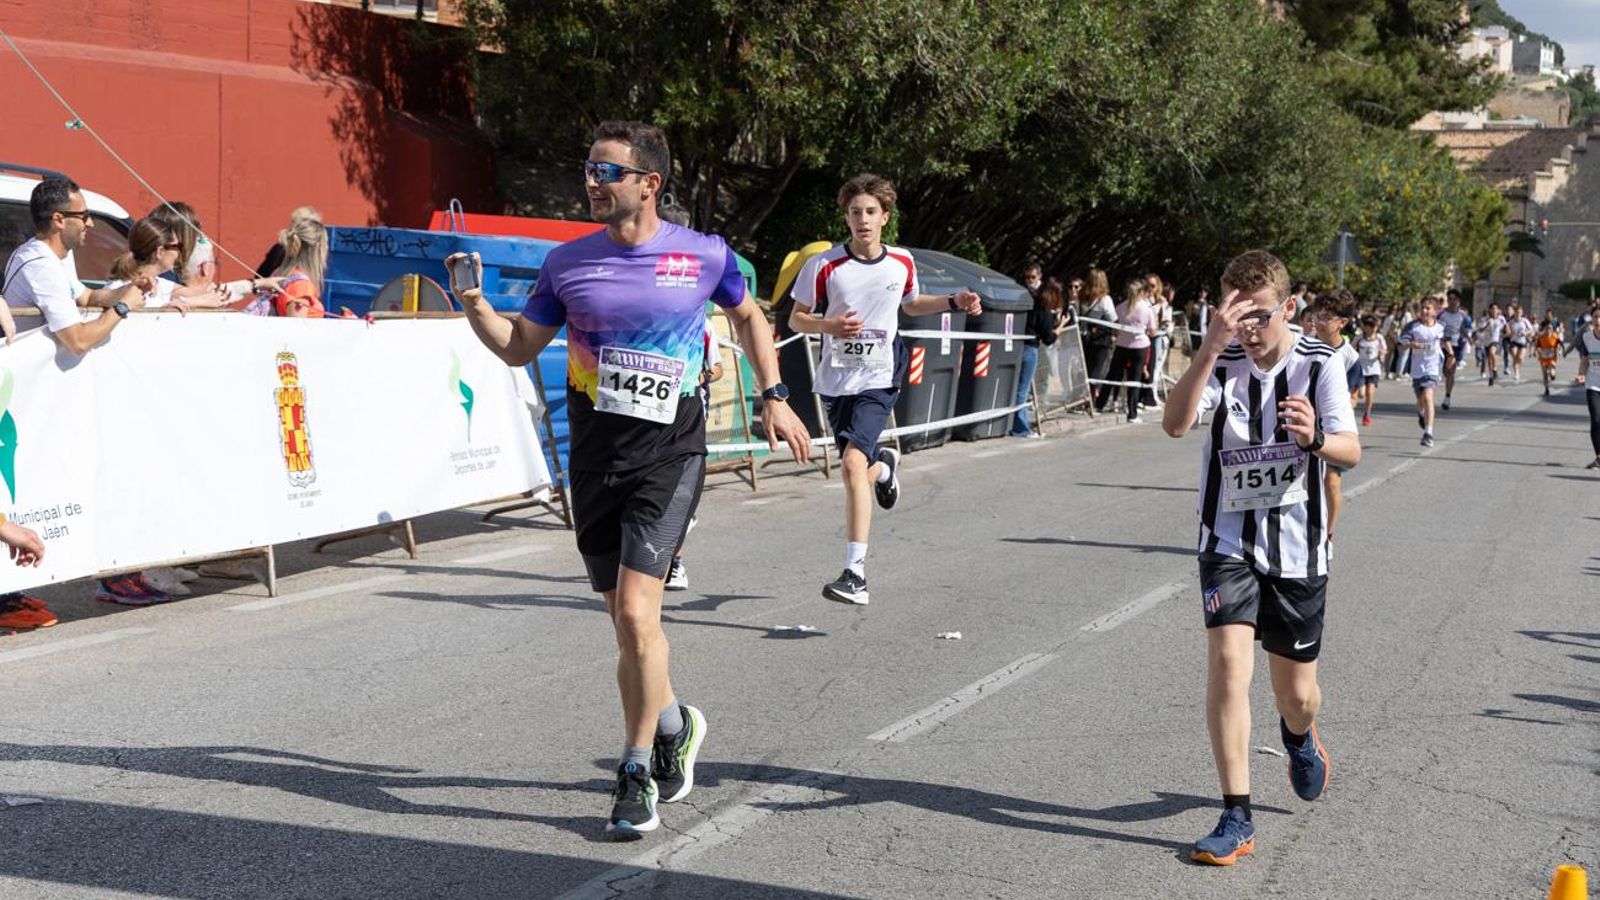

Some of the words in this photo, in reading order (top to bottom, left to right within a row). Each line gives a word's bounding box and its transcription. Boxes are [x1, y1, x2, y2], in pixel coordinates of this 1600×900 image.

[844, 342, 874, 355] 297
[609, 371, 671, 401] 1426
[1233, 463, 1296, 490] 1514
[9, 505, 62, 525] Municipal
[64, 502, 83, 517] de
